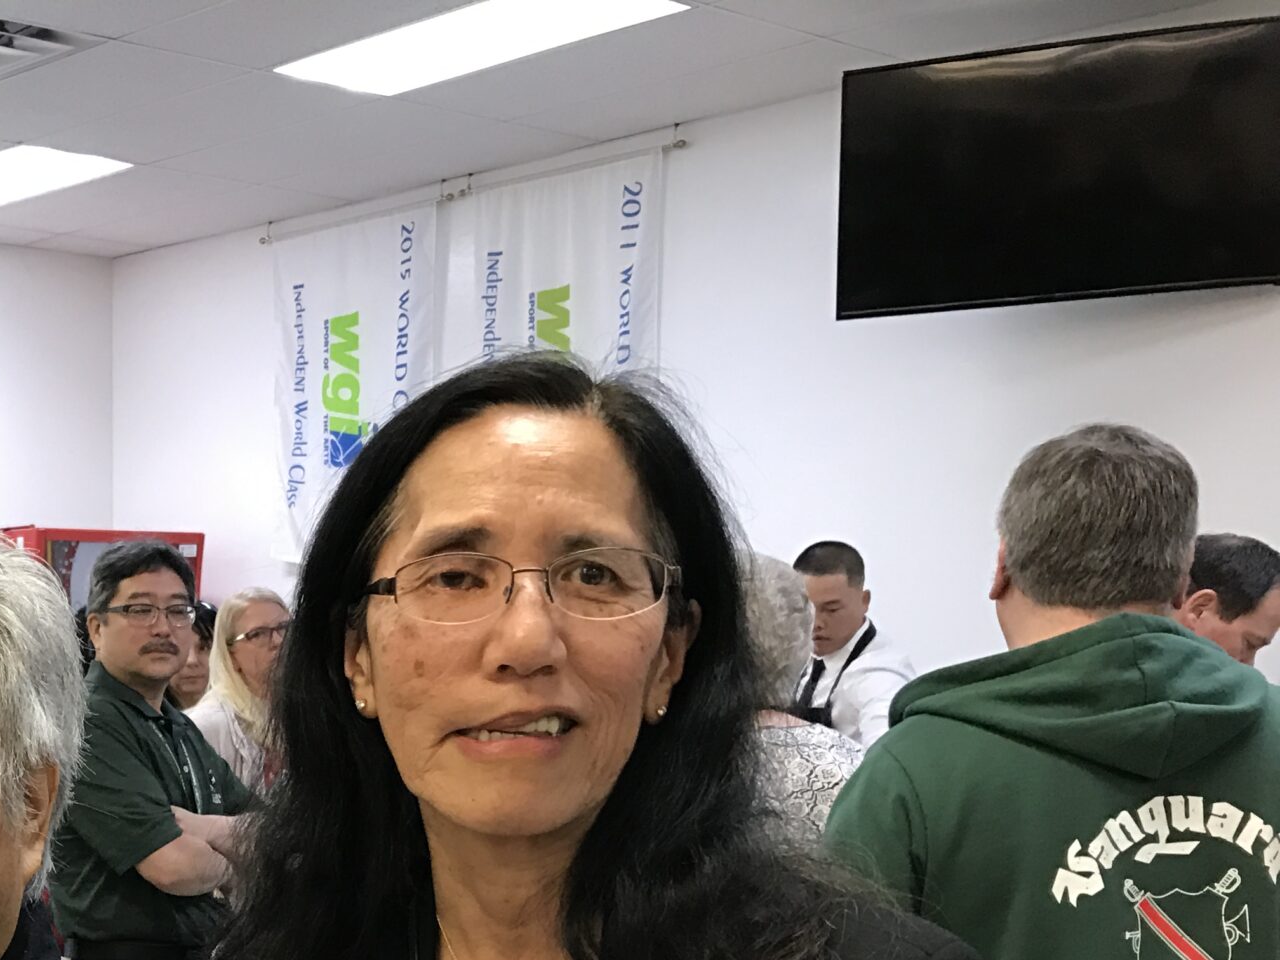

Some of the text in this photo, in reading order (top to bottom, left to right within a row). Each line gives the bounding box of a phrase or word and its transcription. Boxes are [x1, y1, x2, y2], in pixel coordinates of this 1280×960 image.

[400, 221, 415, 281] 2015
[616, 181, 643, 365] 2011 WORLD
[394, 289, 410, 382] WORLD
[528, 292, 536, 331] SPORT
[323, 358, 330, 371] OF
